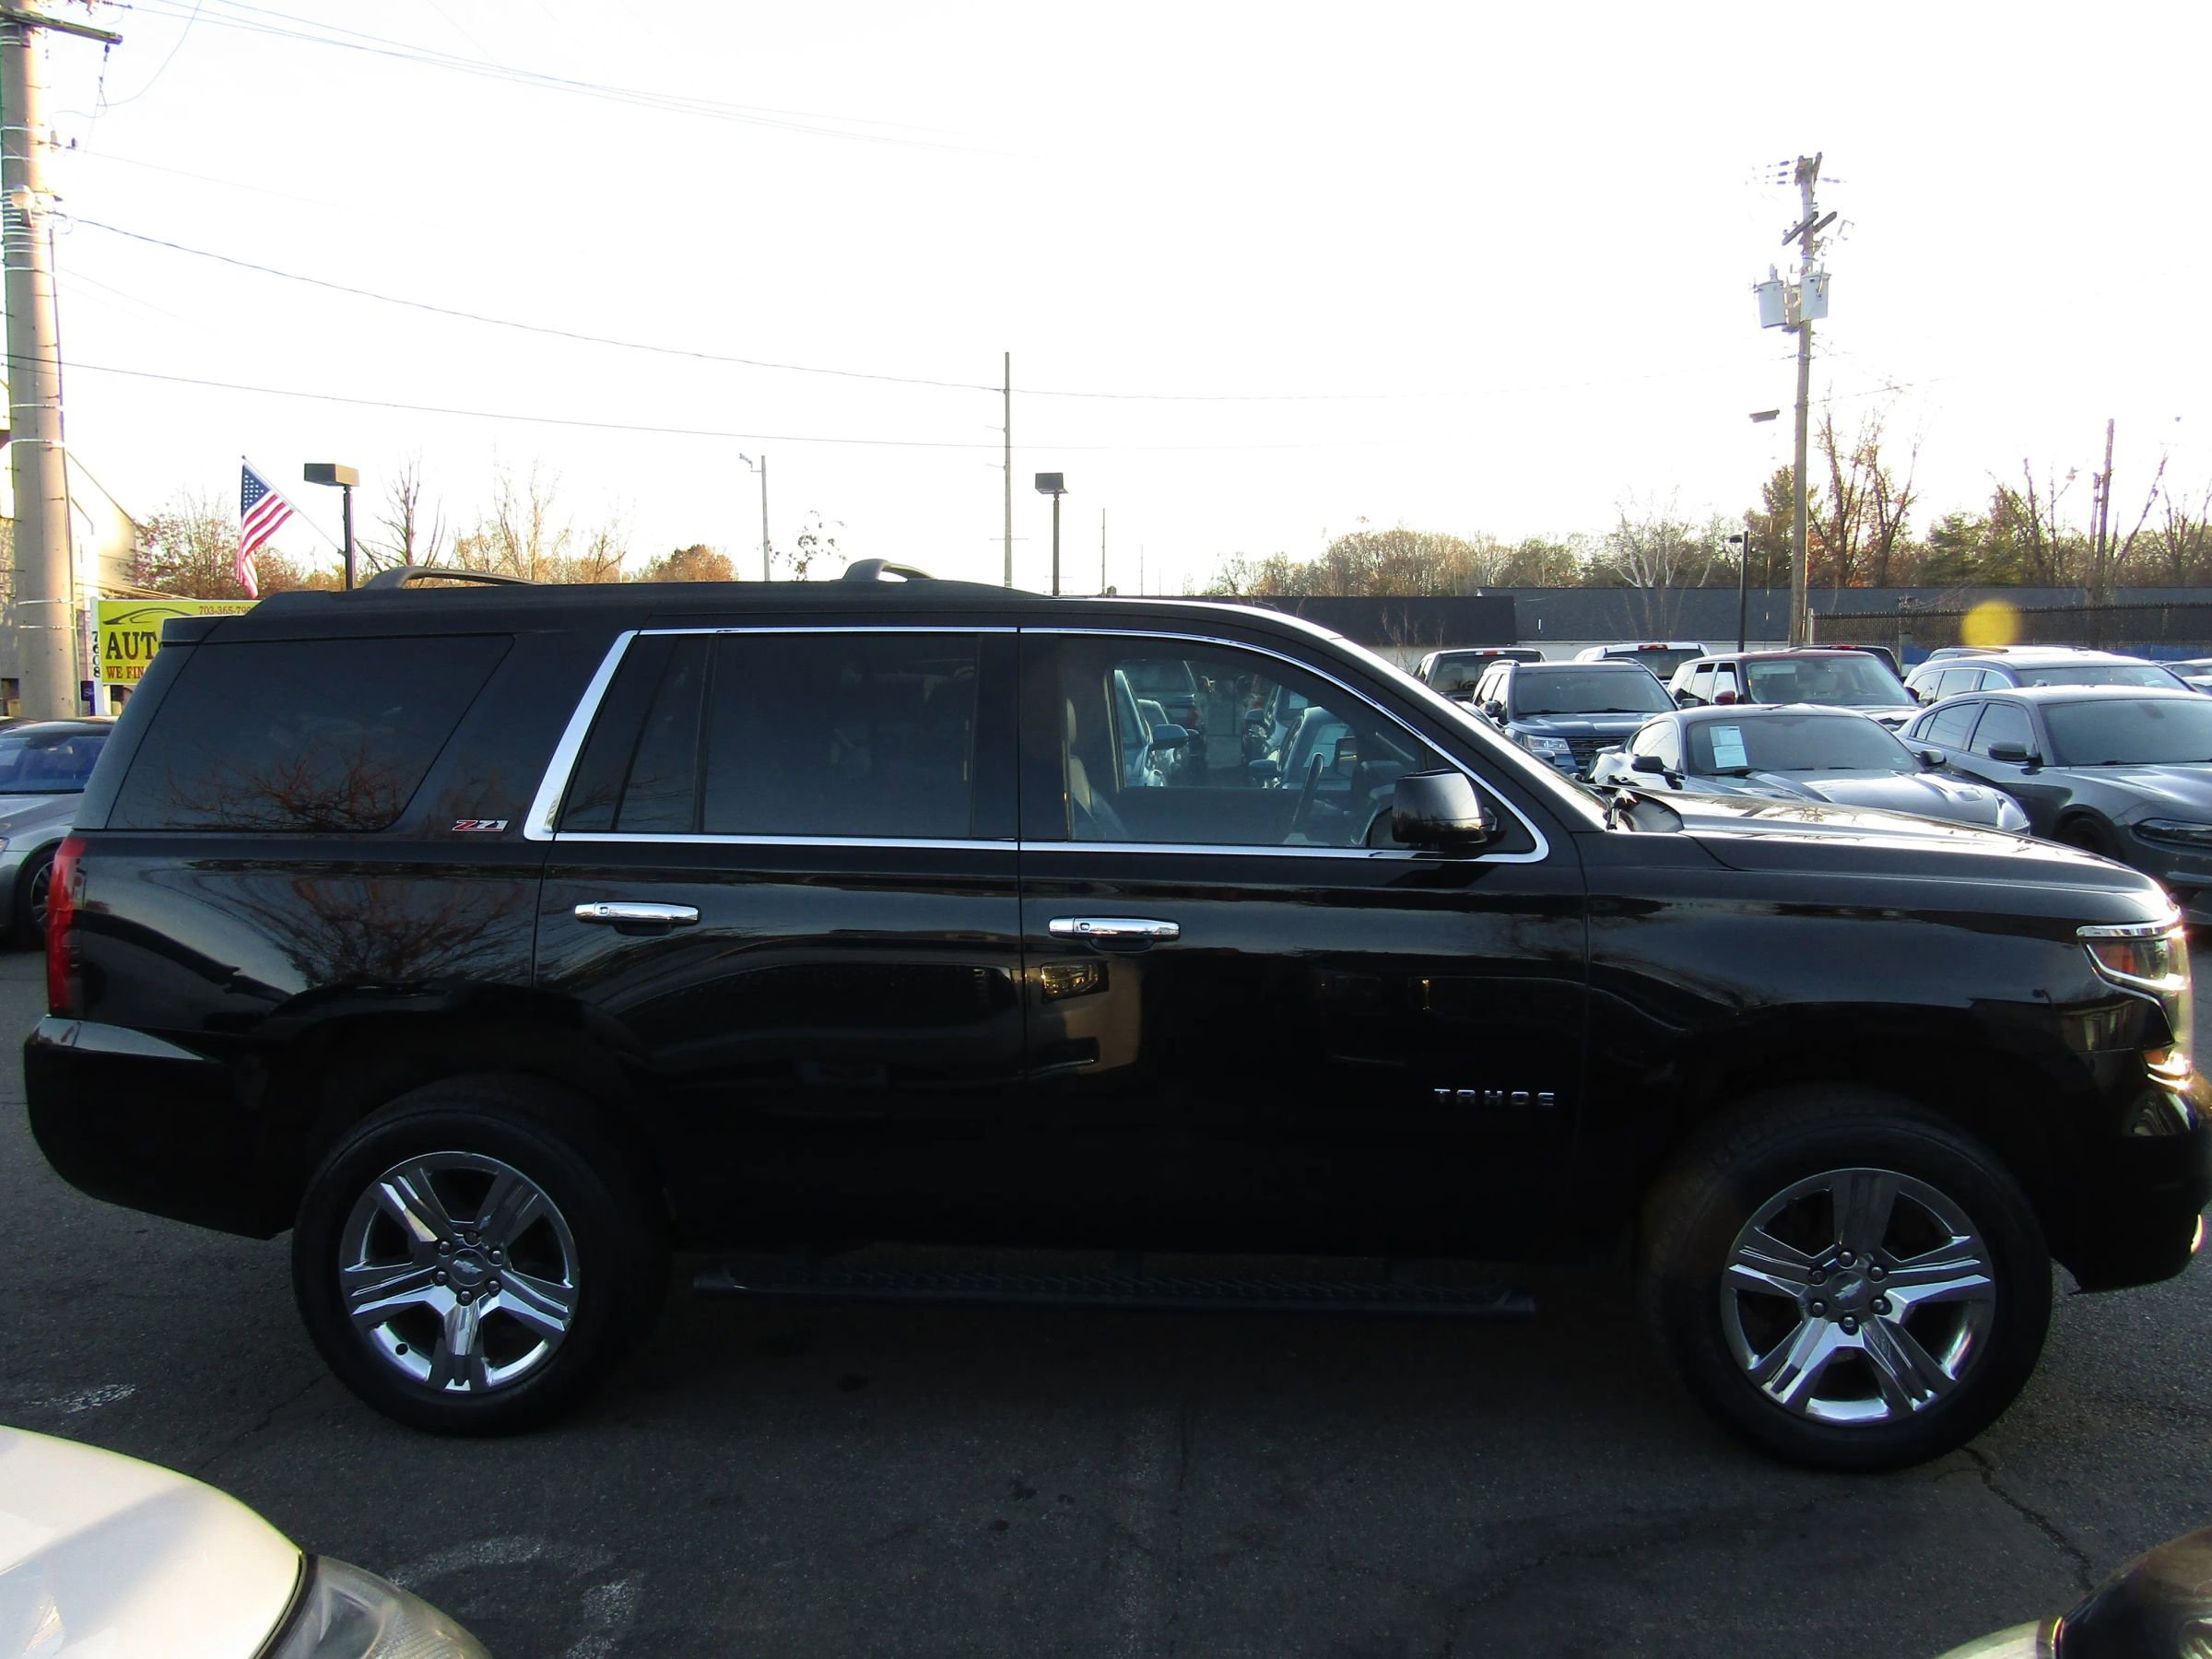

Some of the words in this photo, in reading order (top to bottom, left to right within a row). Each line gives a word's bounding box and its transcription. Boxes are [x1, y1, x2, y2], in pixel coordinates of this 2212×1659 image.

[106, 631, 162, 660] AUT
[106, 666, 123, 678] WE
[452, 819, 509, 831] Z71
[1434, 1088, 1555, 1105] TAHOE
